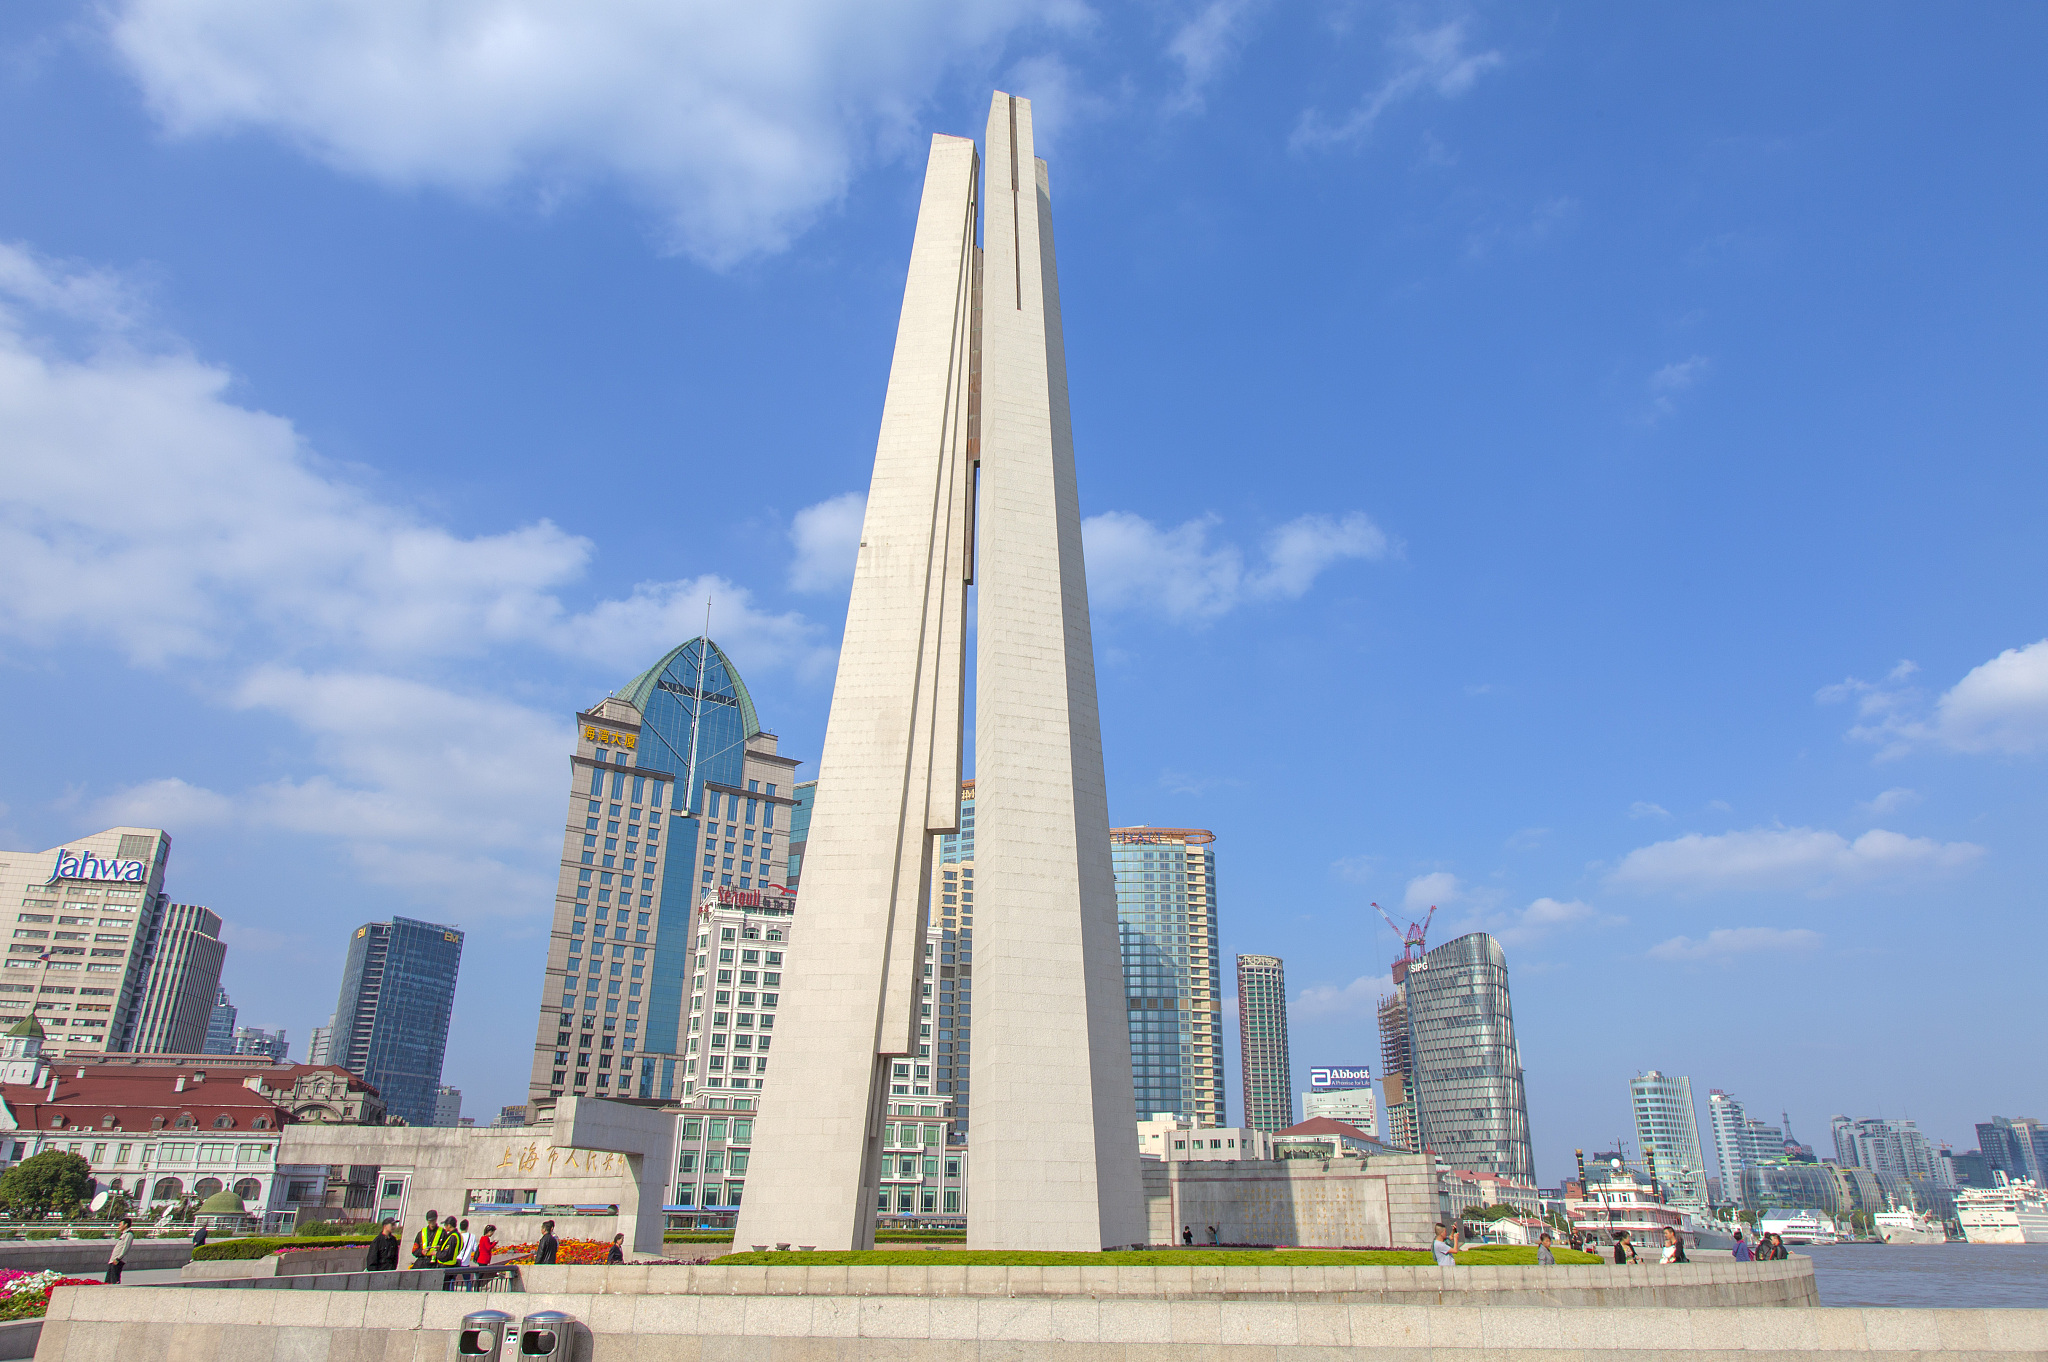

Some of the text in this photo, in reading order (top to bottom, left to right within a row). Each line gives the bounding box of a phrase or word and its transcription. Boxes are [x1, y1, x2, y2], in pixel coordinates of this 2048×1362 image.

[583, 725, 637, 749] 海湾大厦
[1116, 832, 1163, 845] HYATT
[44, 848, 145, 882] Jahwa
[718, 885, 761, 907] Seagull
[1410, 961, 1428, 973] SIPG
[1331, 1069, 1370, 1079] Abbott
